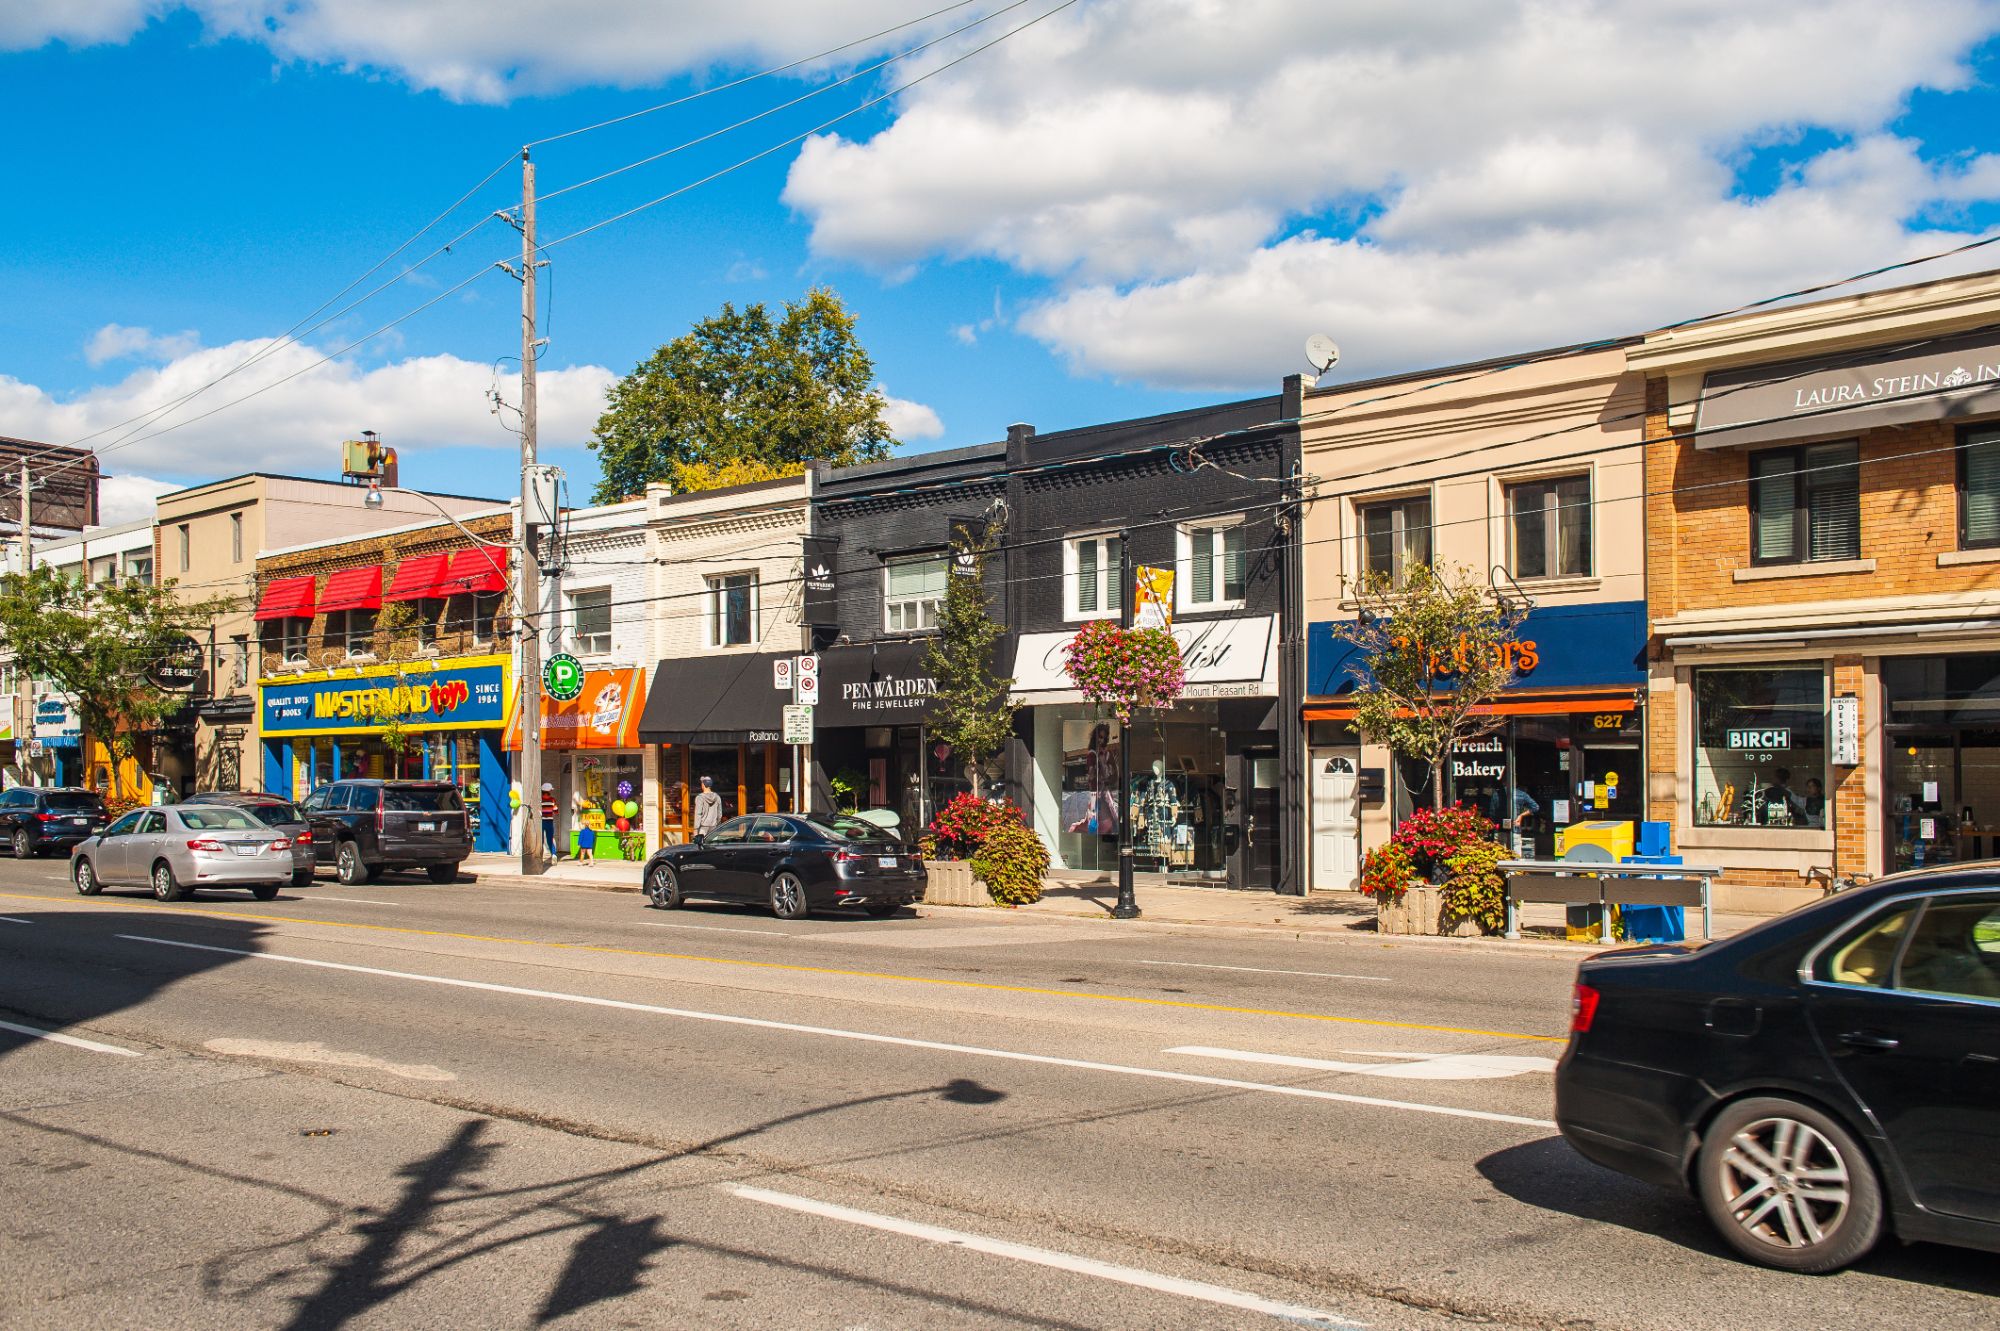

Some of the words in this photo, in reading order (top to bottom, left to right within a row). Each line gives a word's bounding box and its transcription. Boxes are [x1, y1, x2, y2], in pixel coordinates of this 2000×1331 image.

[1794, 383, 1865, 408] LAURA
[1872, 372, 1940, 397] STEIN
[475, 683, 500, 694] SINCE
[544, 680, 583, 700] PARKING
[842, 677, 938, 700] PENWARDEN
[1186, 686, 1210, 697] Mount
[1212, 684, 1246, 697] Pleasant
[1248, 683, 1259, 696] Rd
[430, 679, 469, 715] toys
[477, 695, 498, 704] 1984
[852, 701, 872, 710] FINE
[875, 698, 926, 709] JEWELLERY
[1593, 714, 1623, 729] 627
[749, 731, 779, 742] Positano
[1730, 731, 1788, 748] BIRCH
[1453, 737, 1503, 752] French
[1745, 753, 1755, 761] to
[1760, 753, 1773, 763] go
[1453, 761, 1506, 780] Bakery
